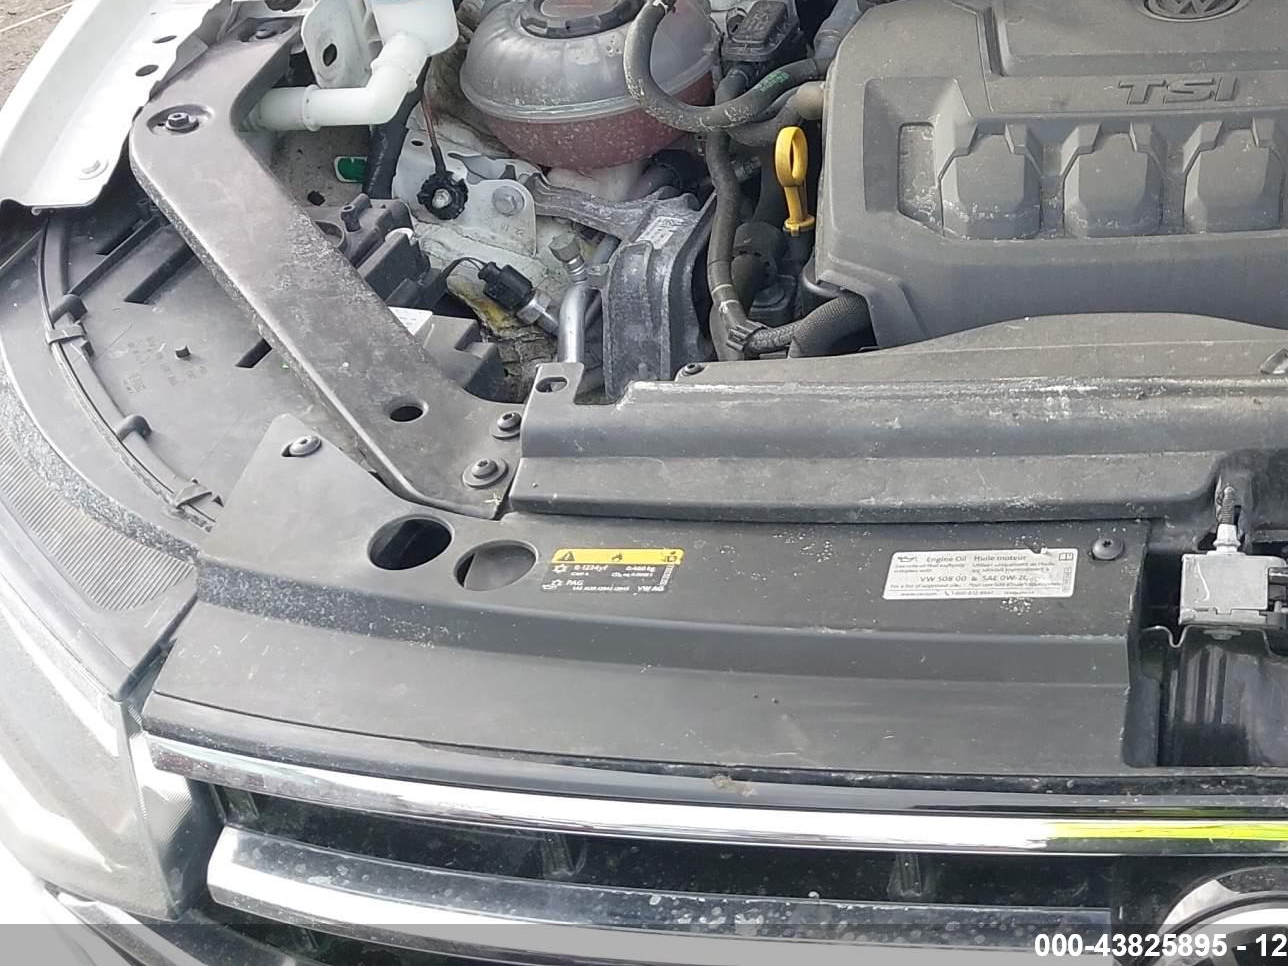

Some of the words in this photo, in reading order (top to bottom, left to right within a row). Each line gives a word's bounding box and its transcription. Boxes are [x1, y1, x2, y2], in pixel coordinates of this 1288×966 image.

[1118, 77, 1238, 105] TSI
[926, 556, 953, 564] Engine
[973, 554, 995, 562] Huile
